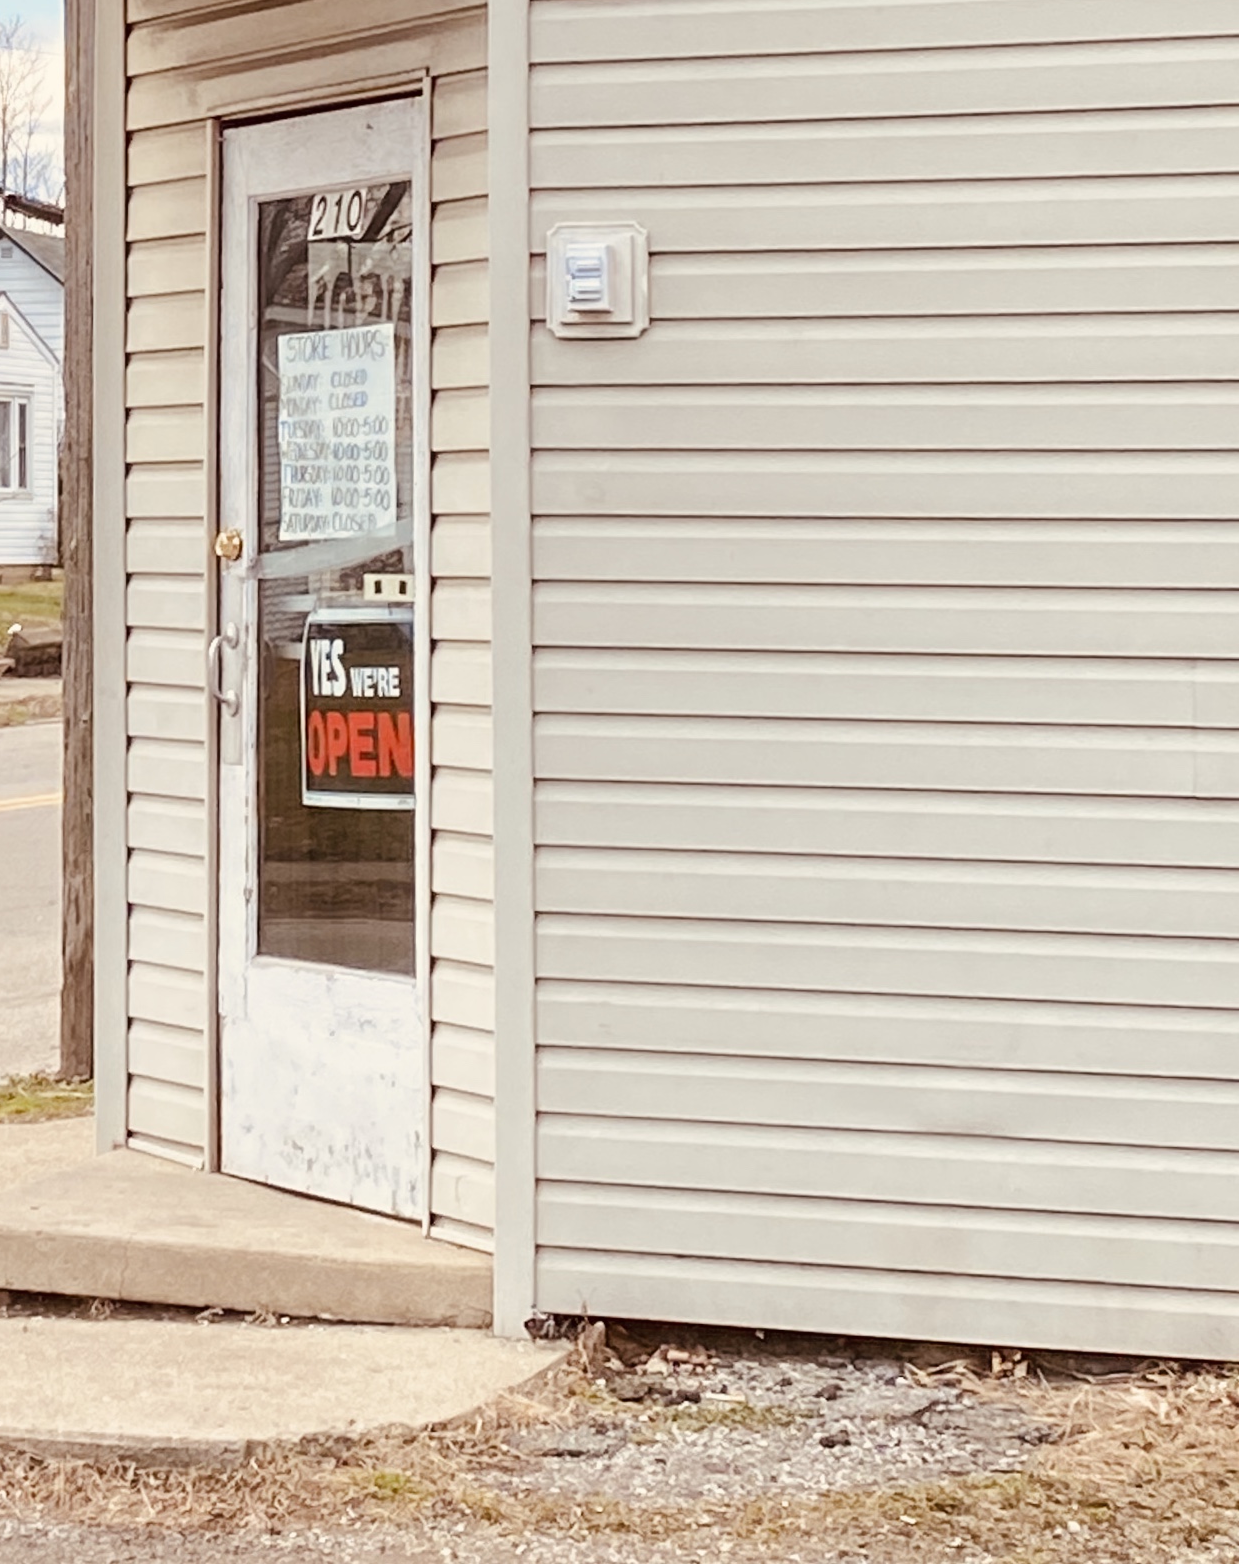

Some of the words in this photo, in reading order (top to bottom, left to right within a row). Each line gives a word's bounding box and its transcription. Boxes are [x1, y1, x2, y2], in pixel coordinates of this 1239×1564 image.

[312, 190, 362, 236] 210
[285, 333, 332, 363] STORE
[330, 368, 368, 389] CLOSED
[328, 391, 369, 411] CLOSED
[332, 511, 377, 533] CLOSED
[310, 638, 346, 697] YES
[350, 667, 401, 697] WE'RE
[307, 710, 415, 778] OPEN
